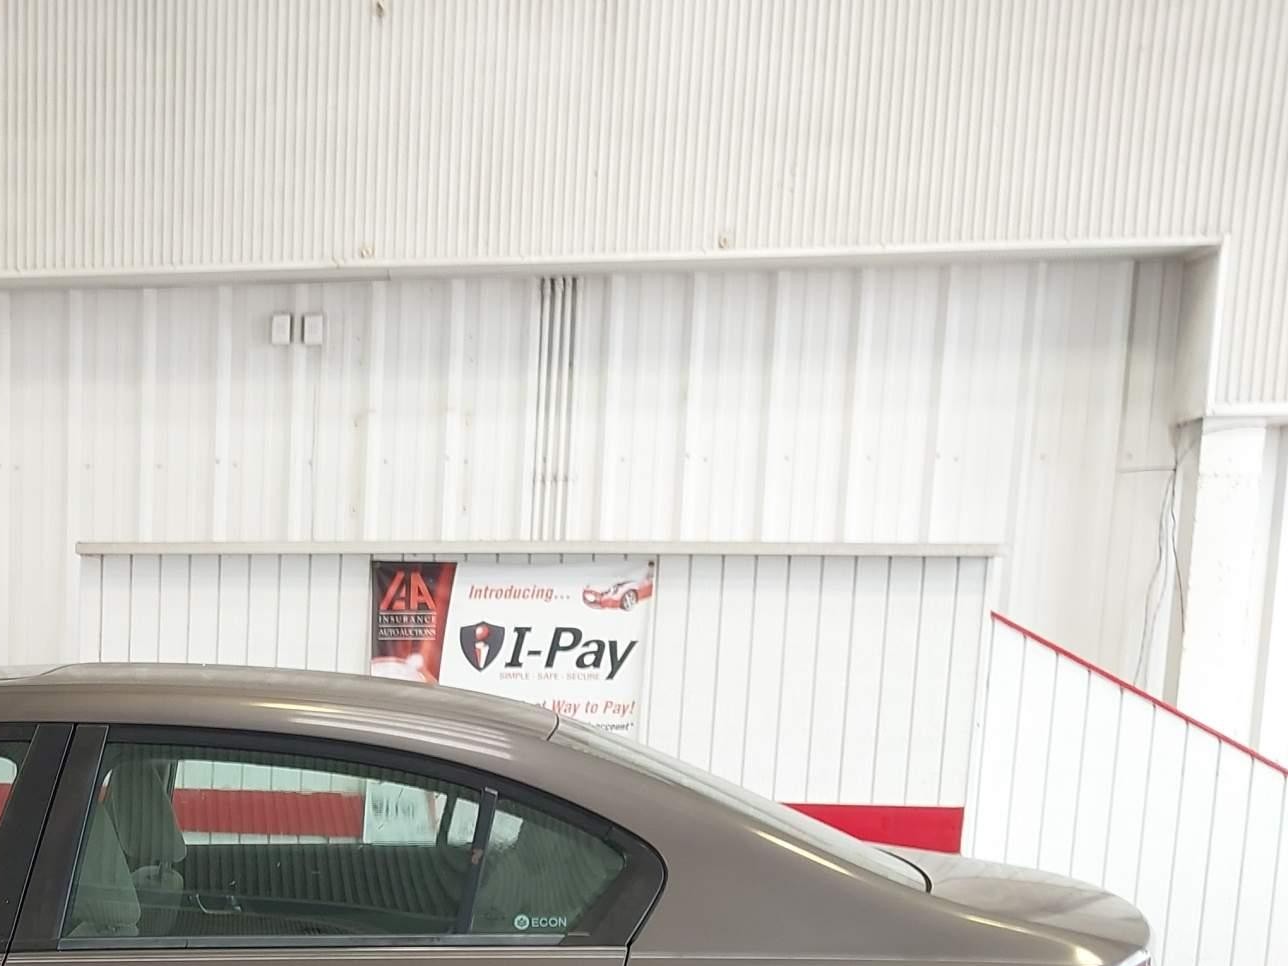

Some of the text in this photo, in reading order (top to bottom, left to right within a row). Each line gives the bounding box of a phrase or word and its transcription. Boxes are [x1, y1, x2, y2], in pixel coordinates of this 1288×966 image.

[469, 584, 571, 603] Introducing...
[504, 626, 638, 680] I-Pay
[552, 699, 580, 717] Way
[585, 700, 599, 714] to
[602, 700, 636, 718] Pay!
[531, 917, 567, 928] ECON
